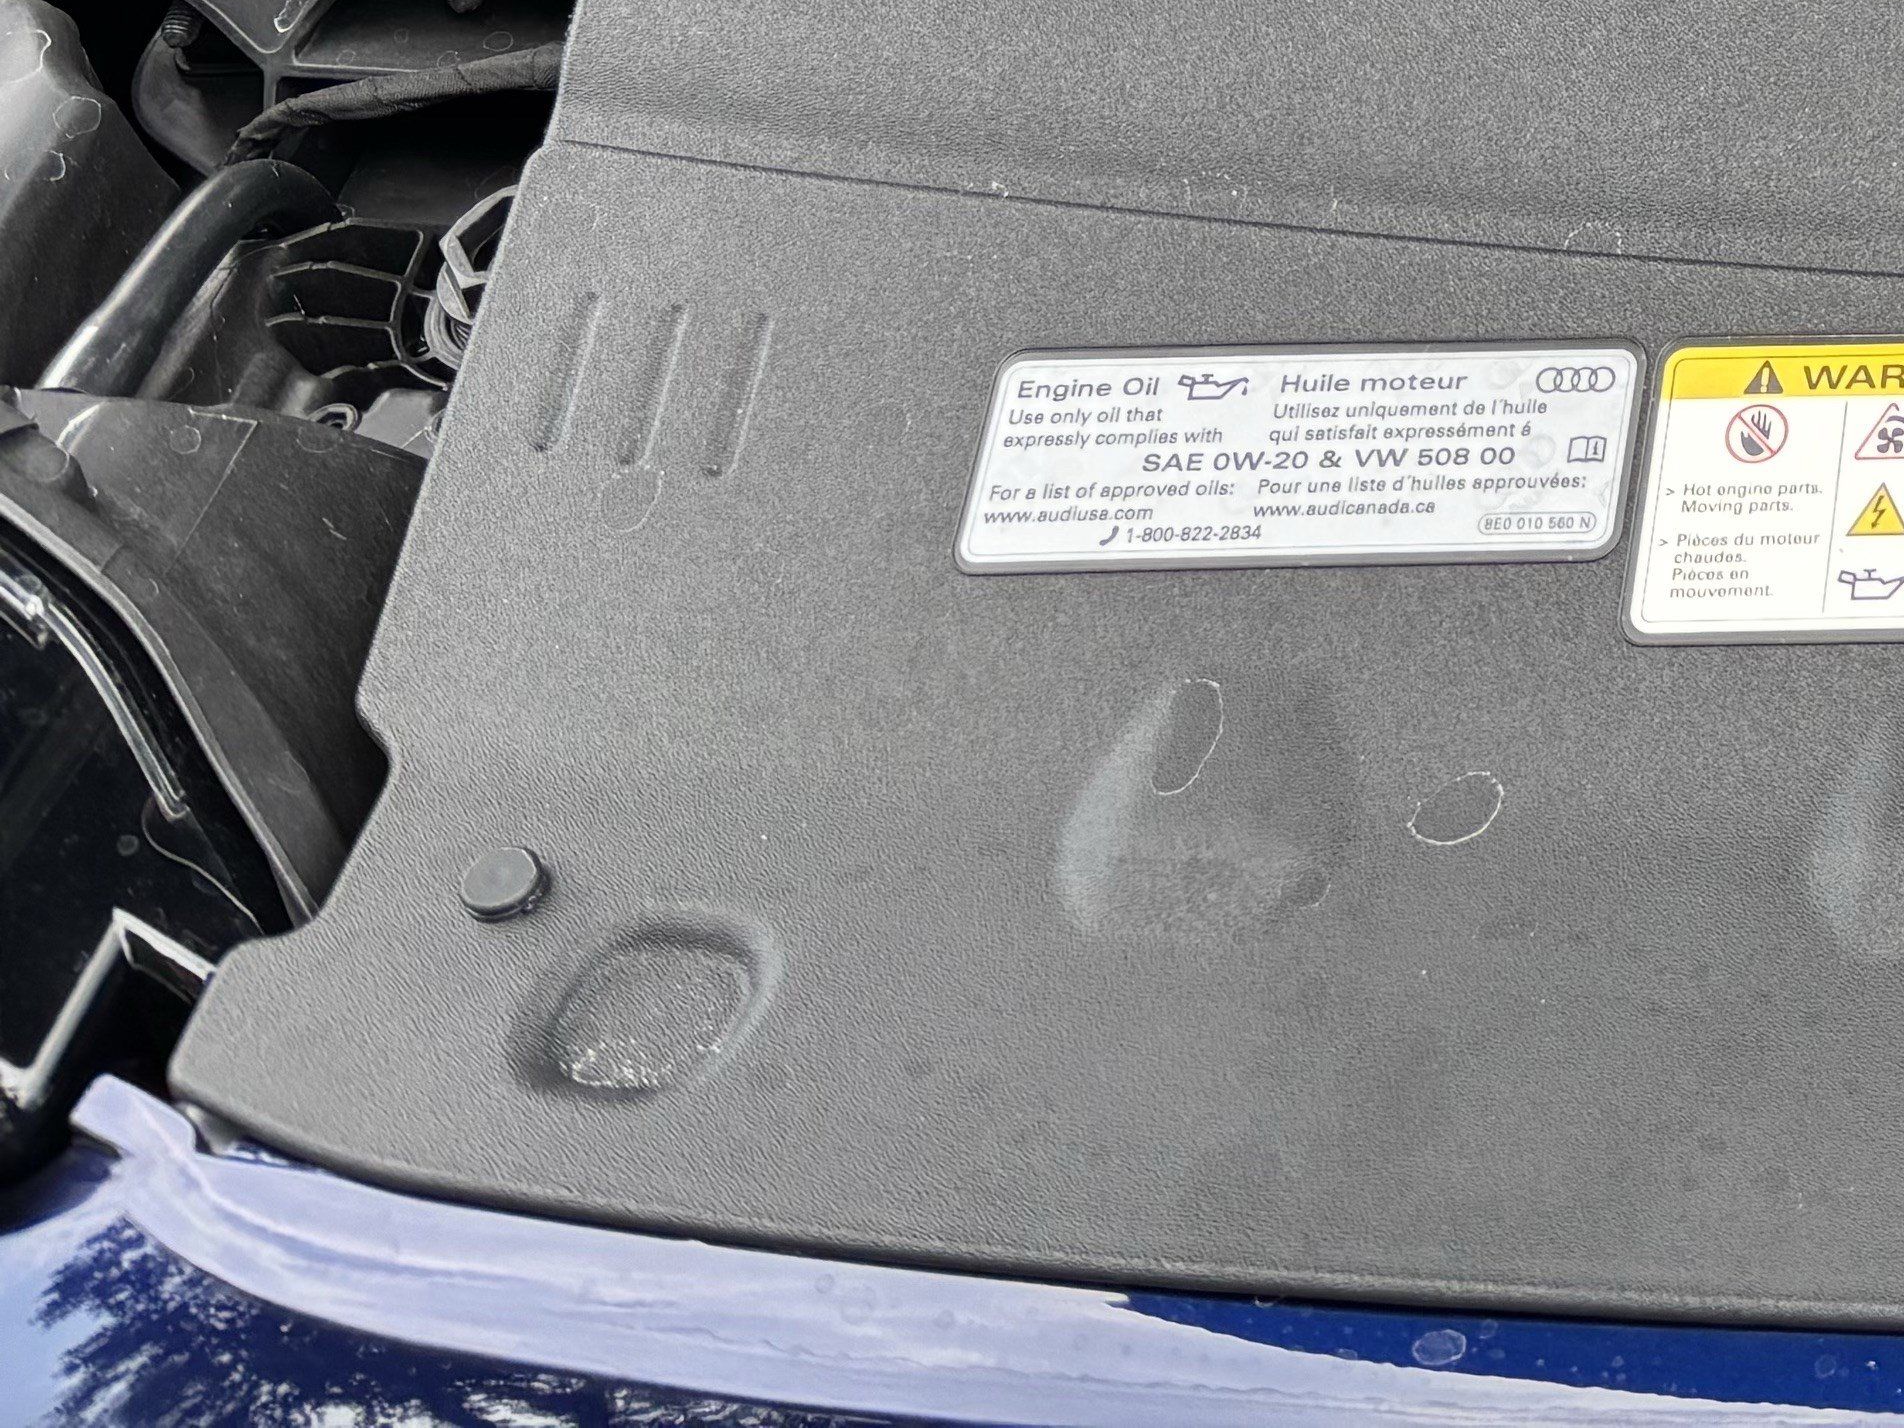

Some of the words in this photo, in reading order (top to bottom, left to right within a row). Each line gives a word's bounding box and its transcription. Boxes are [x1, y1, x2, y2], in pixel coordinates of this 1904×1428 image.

[1017, 379, 1111, 402] Engine
[1123, 376, 1160, 396] Oil
[1280, 374, 1350, 393] Huile
[1361, 375, 1468, 392] moteur
[1008, 409, 1044, 425] Use
[1050, 408, 1091, 426] only
[1097, 408, 1119, 423] oil
[1126, 407, 1162, 422] that
[1273, 402, 1339, 419] Utilisez
[1345, 402, 1458, 420] uniquement
[1463, 400, 1486, 415] de
[1003, 431, 1090, 450] expressly
[1095, 428, 1178, 448] complies
[1184, 427, 1223, 443] with
[1269, 425, 1299, 444] qui
[1305, 423, 1377, 441] satisfait
[1383, 422, 1515, 443] expressément
[1142, 452, 1204, 472] SAE
[1213, 450, 1308, 471] 0W-20
[1319, 450, 1342, 468] &
[1354, 448, 1408, 467] VW
[1417, 447, 1470, 465] 508
[1480, 446, 1516, 465] 00
[989, 485, 1021, 501] For
[1025, 488, 1036, 500] a
[1042, 483, 1070, 499] list
[1075, 482, 1096, 499] of
[1100, 481, 1189, 501] approved
[1196, 480, 1234, 496] oils:
[1258, 479, 1301, 495] Pour
[1307, 481, 1342, 493] une
[1348, 476, 1385, 493] liste
[1472, 475, 1587, 497] approuvées:
[1683, 483, 1711, 496] Hot
[1717, 484, 1772, 498] engine
[1778, 483, 1823, 497] parts.
[984, 506, 1154, 524] www.audiusa.com
[1253, 499, 1436, 518] www.audicanada.ca
[1681, 500, 1743, 516] Moving
[1749, 500, 1793, 514] parts.
[1517, 517, 1543, 529] 010
[1580, 516, 1591, 528] N
[1127, 525, 1262, 543] 1-800-822-2834
[1677, 532, 1728, 547] Pièces
[1734, 533, 1754, 545] du
[1760, 533, 1820, 545] moteur
[1674, 551, 1746, 564] chaudes.
[1729, 570, 1749, 580] en
[1670, 585, 1773, 598] mouvement.
